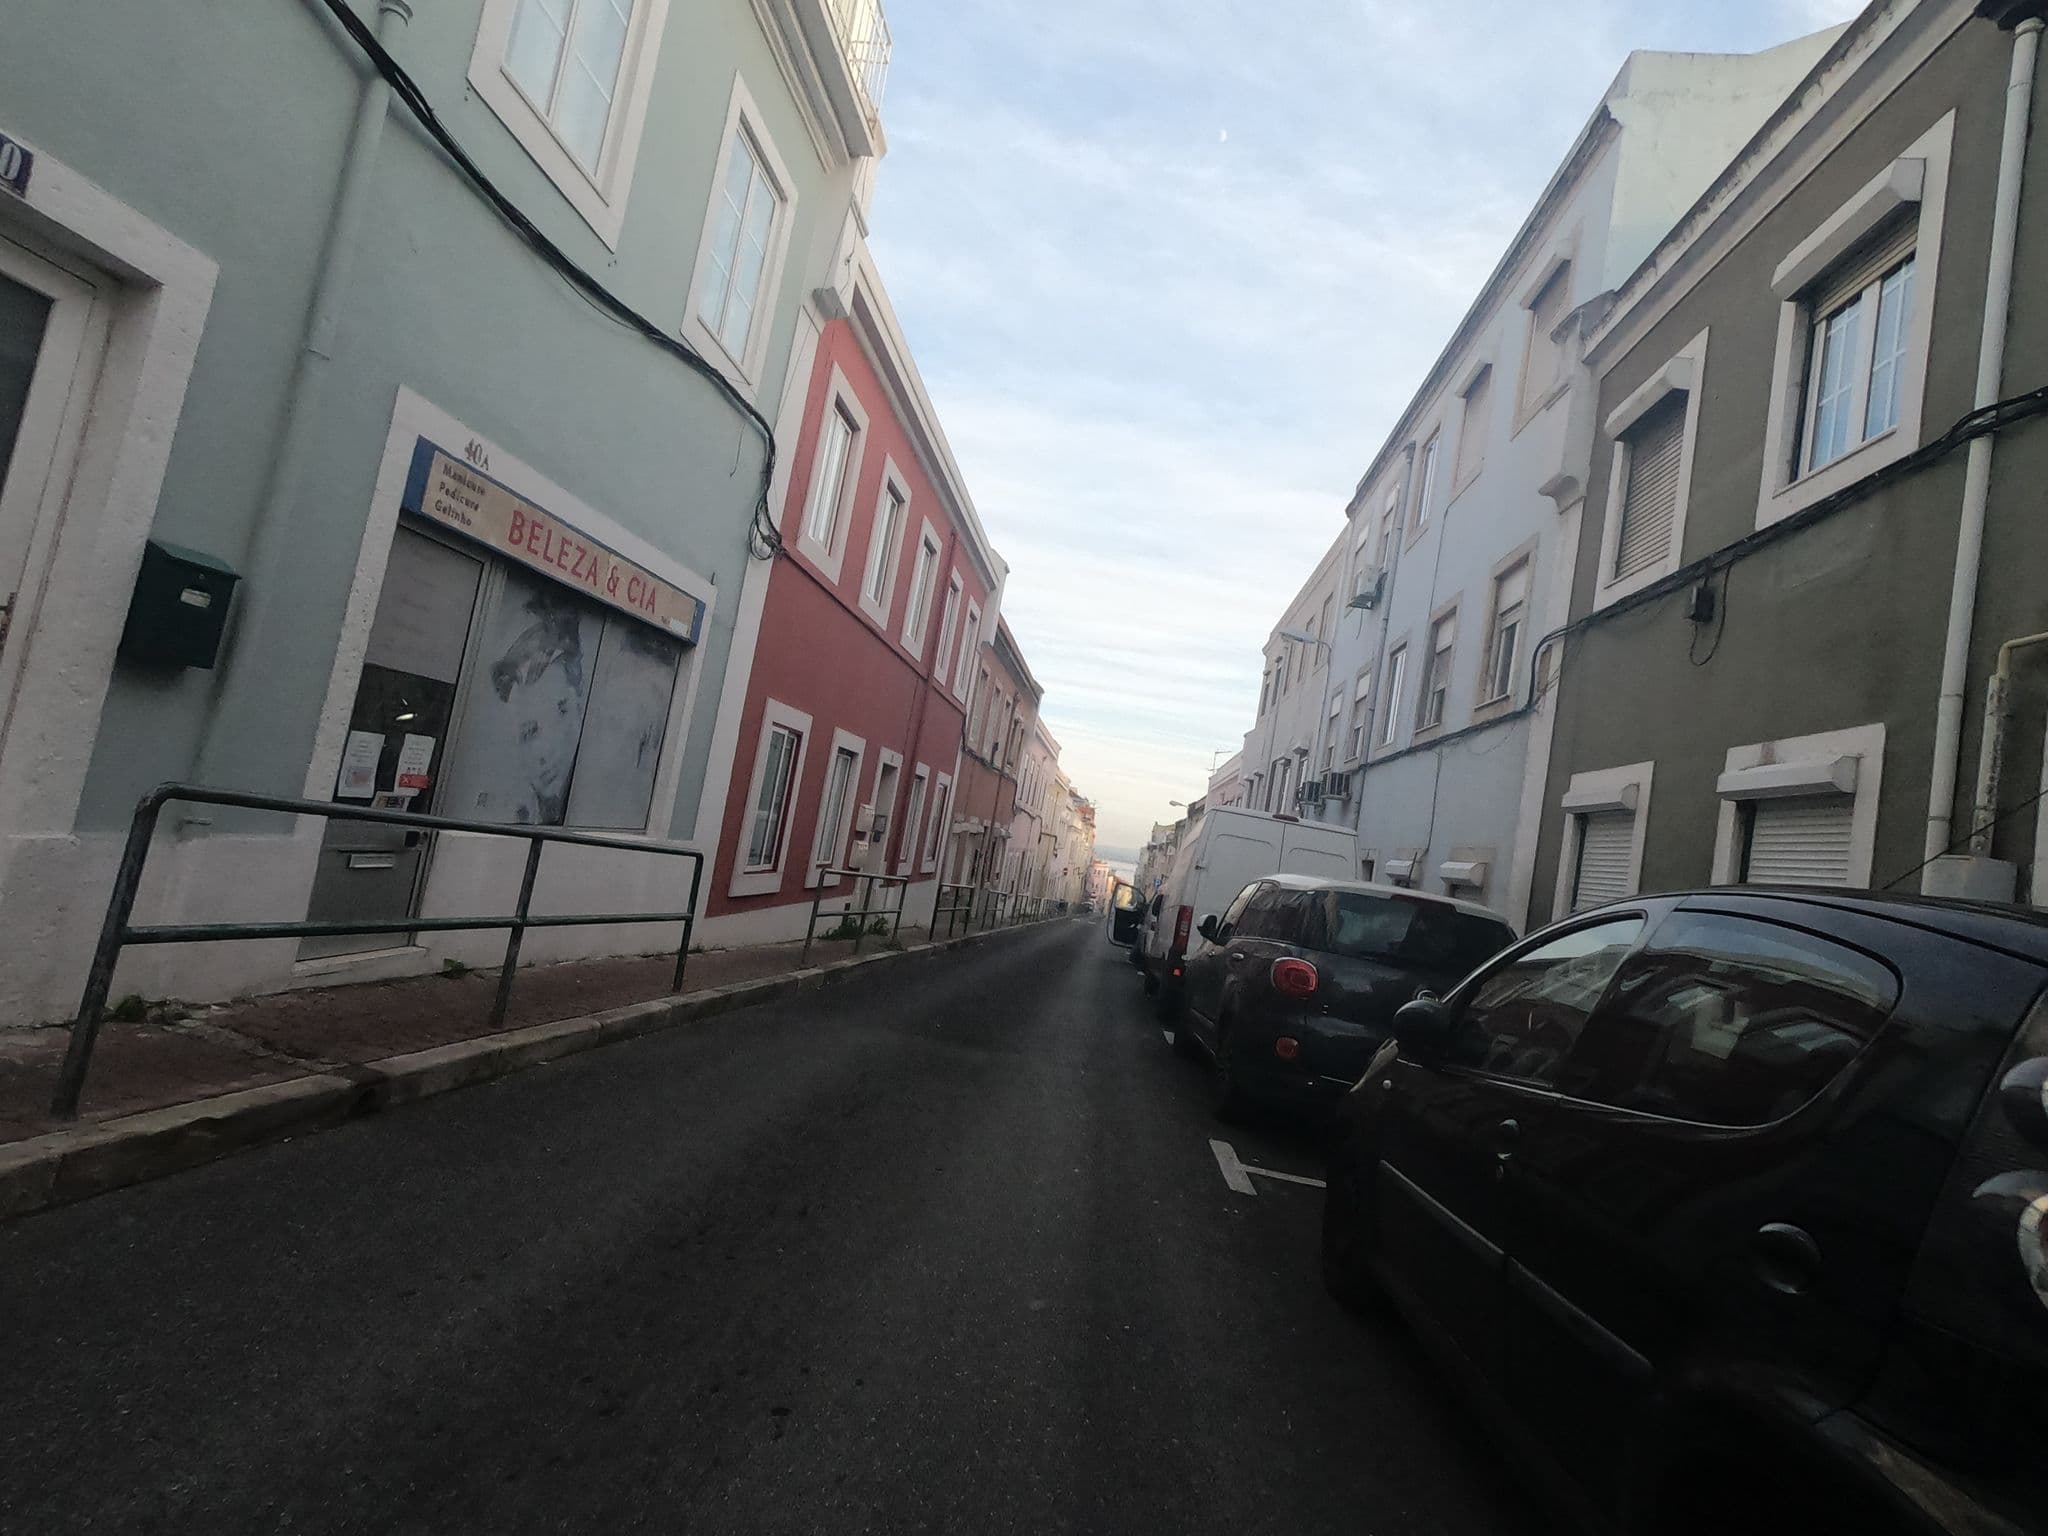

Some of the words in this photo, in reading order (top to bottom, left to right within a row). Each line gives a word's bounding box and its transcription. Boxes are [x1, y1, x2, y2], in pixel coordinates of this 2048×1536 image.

[464, 438, 489, 471] 40A
[442, 464, 487, 496] Manicure
[435, 498, 473, 526] Gelinho
[439, 481, 480, 512] Pedicure
[508, 510, 599, 586] BELEZA
[606, 565, 620, 598] &
[627, 576, 657, 614] CIA
